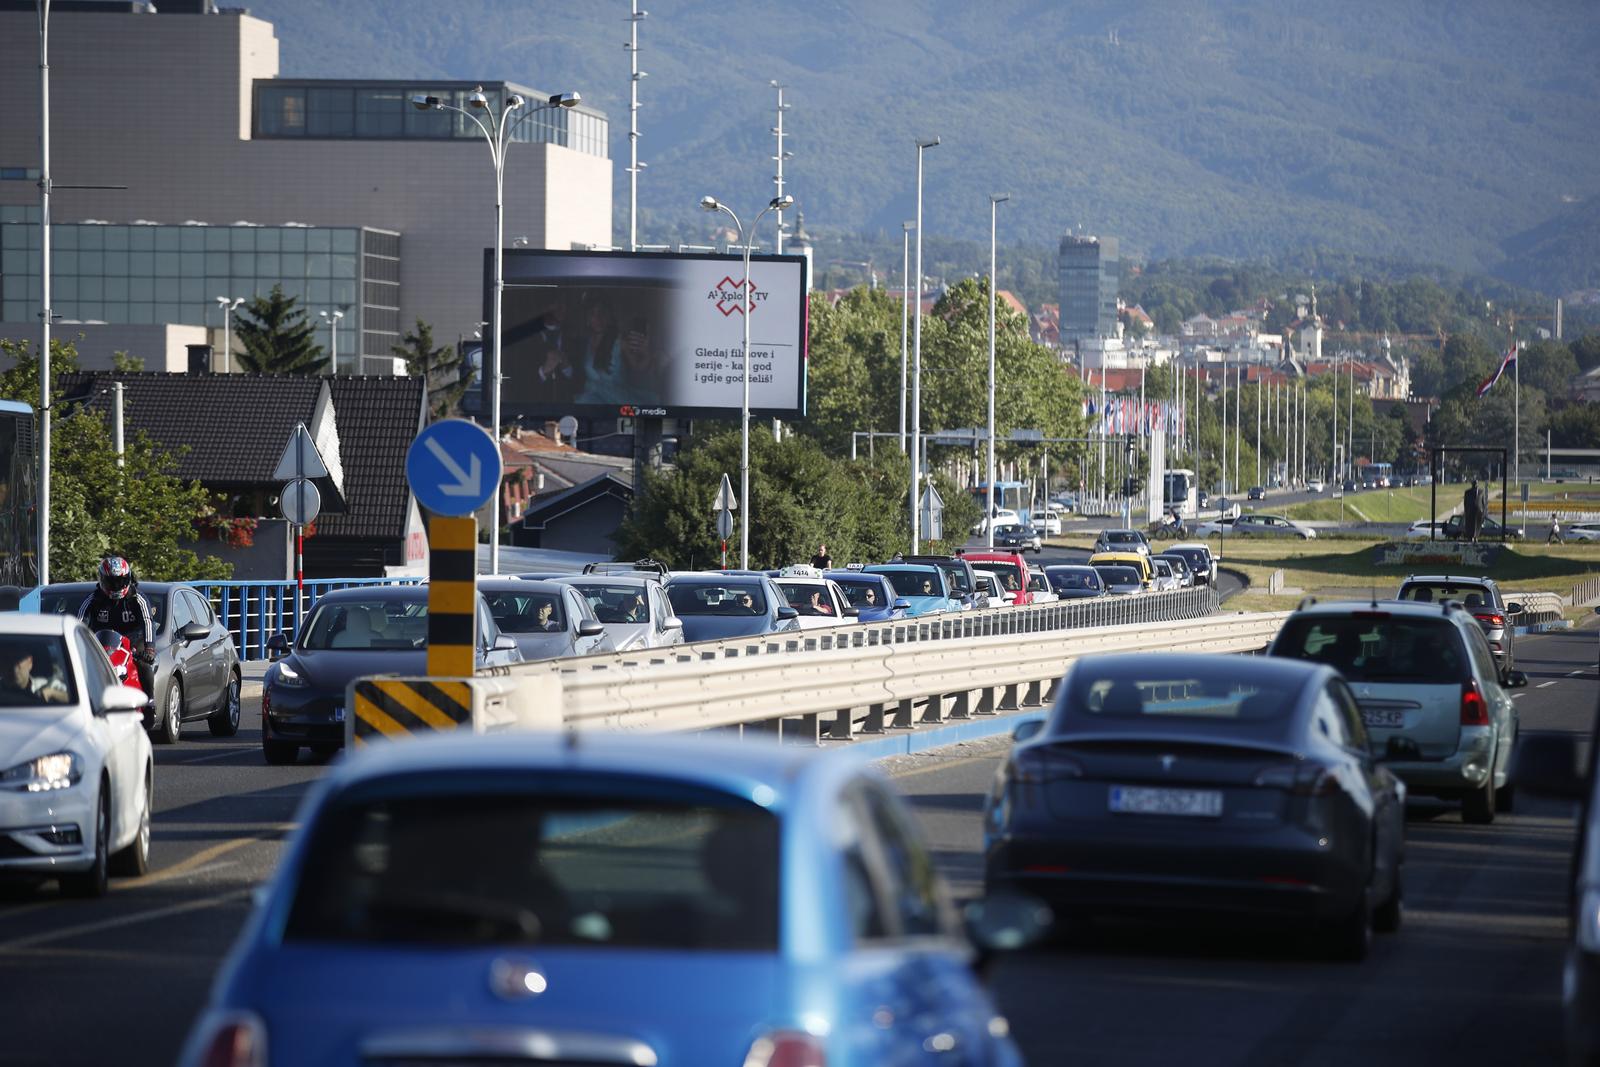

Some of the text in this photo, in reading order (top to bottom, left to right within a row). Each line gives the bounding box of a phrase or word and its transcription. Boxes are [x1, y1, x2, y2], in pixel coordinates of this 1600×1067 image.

[755, 292, 769, 301] TV
[695, 348, 728, 359] Gledaj
[770, 350, 775, 358] i
[695, 361, 723, 371] serije
[731, 361, 751, 370] ka
[753, 362, 772, 372] god
[701, 373, 723, 383] gdje
[725, 374, 744, 384] god
[641, 407, 667, 416] media
